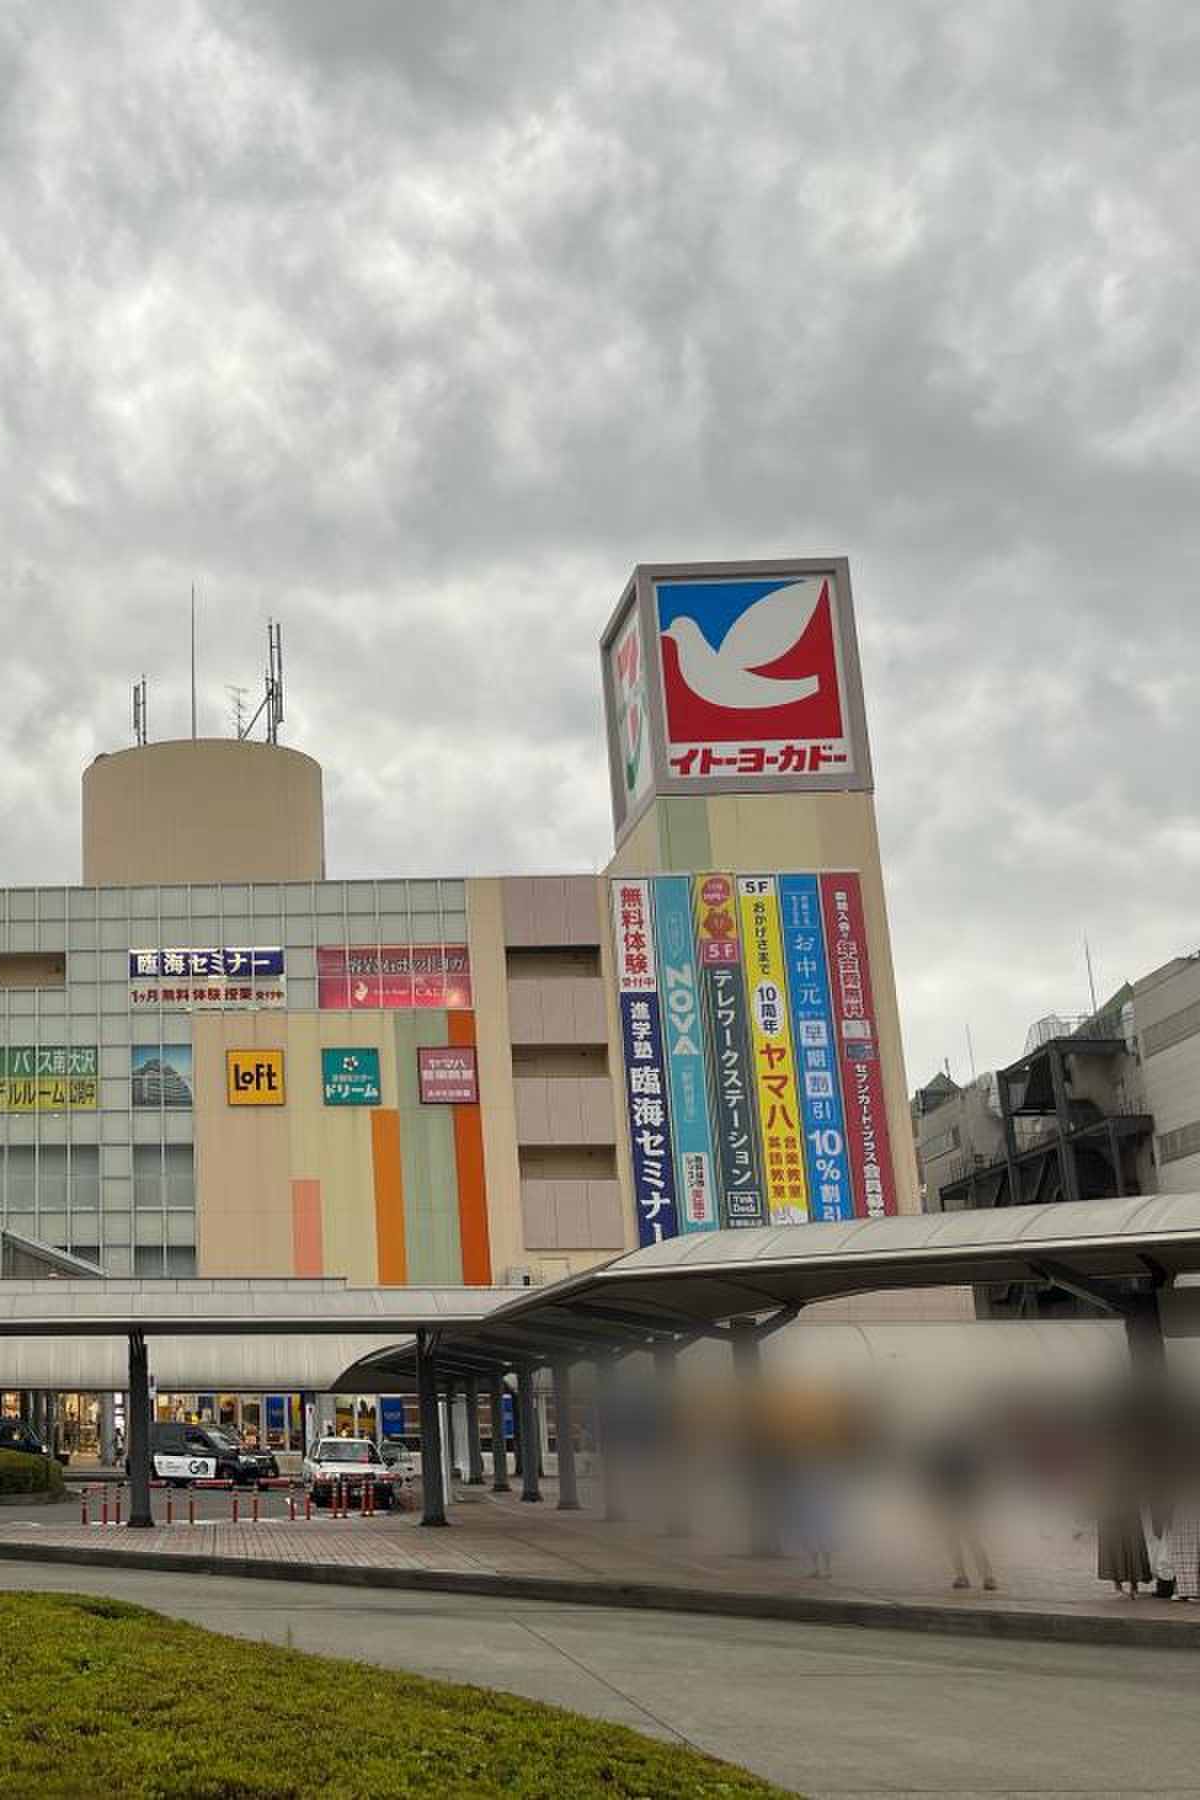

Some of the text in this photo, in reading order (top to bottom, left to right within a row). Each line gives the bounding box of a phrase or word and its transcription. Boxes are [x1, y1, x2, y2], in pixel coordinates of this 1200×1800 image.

[670, 745, 847, 775] イトーヨーカドー
[137, 953, 270, 973] 臨海セミナー
[620, 887, 650, 974] 無料体験
[752, 904, 770, 976] おかげさまで
[793, 934, 822, 1006] お中元
[630, 1001, 653, 1059] 進学塾
[665, 964, 699, 1055] NOVA
[326, 1083, 378, 1098] ドリーム
[429, 1059, 467, 1069] ヤマハ
[713, 970, 751, 1185] テレワークステーション
[760, 1044, 794, 1130] ヤマハ
[630, 1067, 670, 1242] 臨海セミナー
